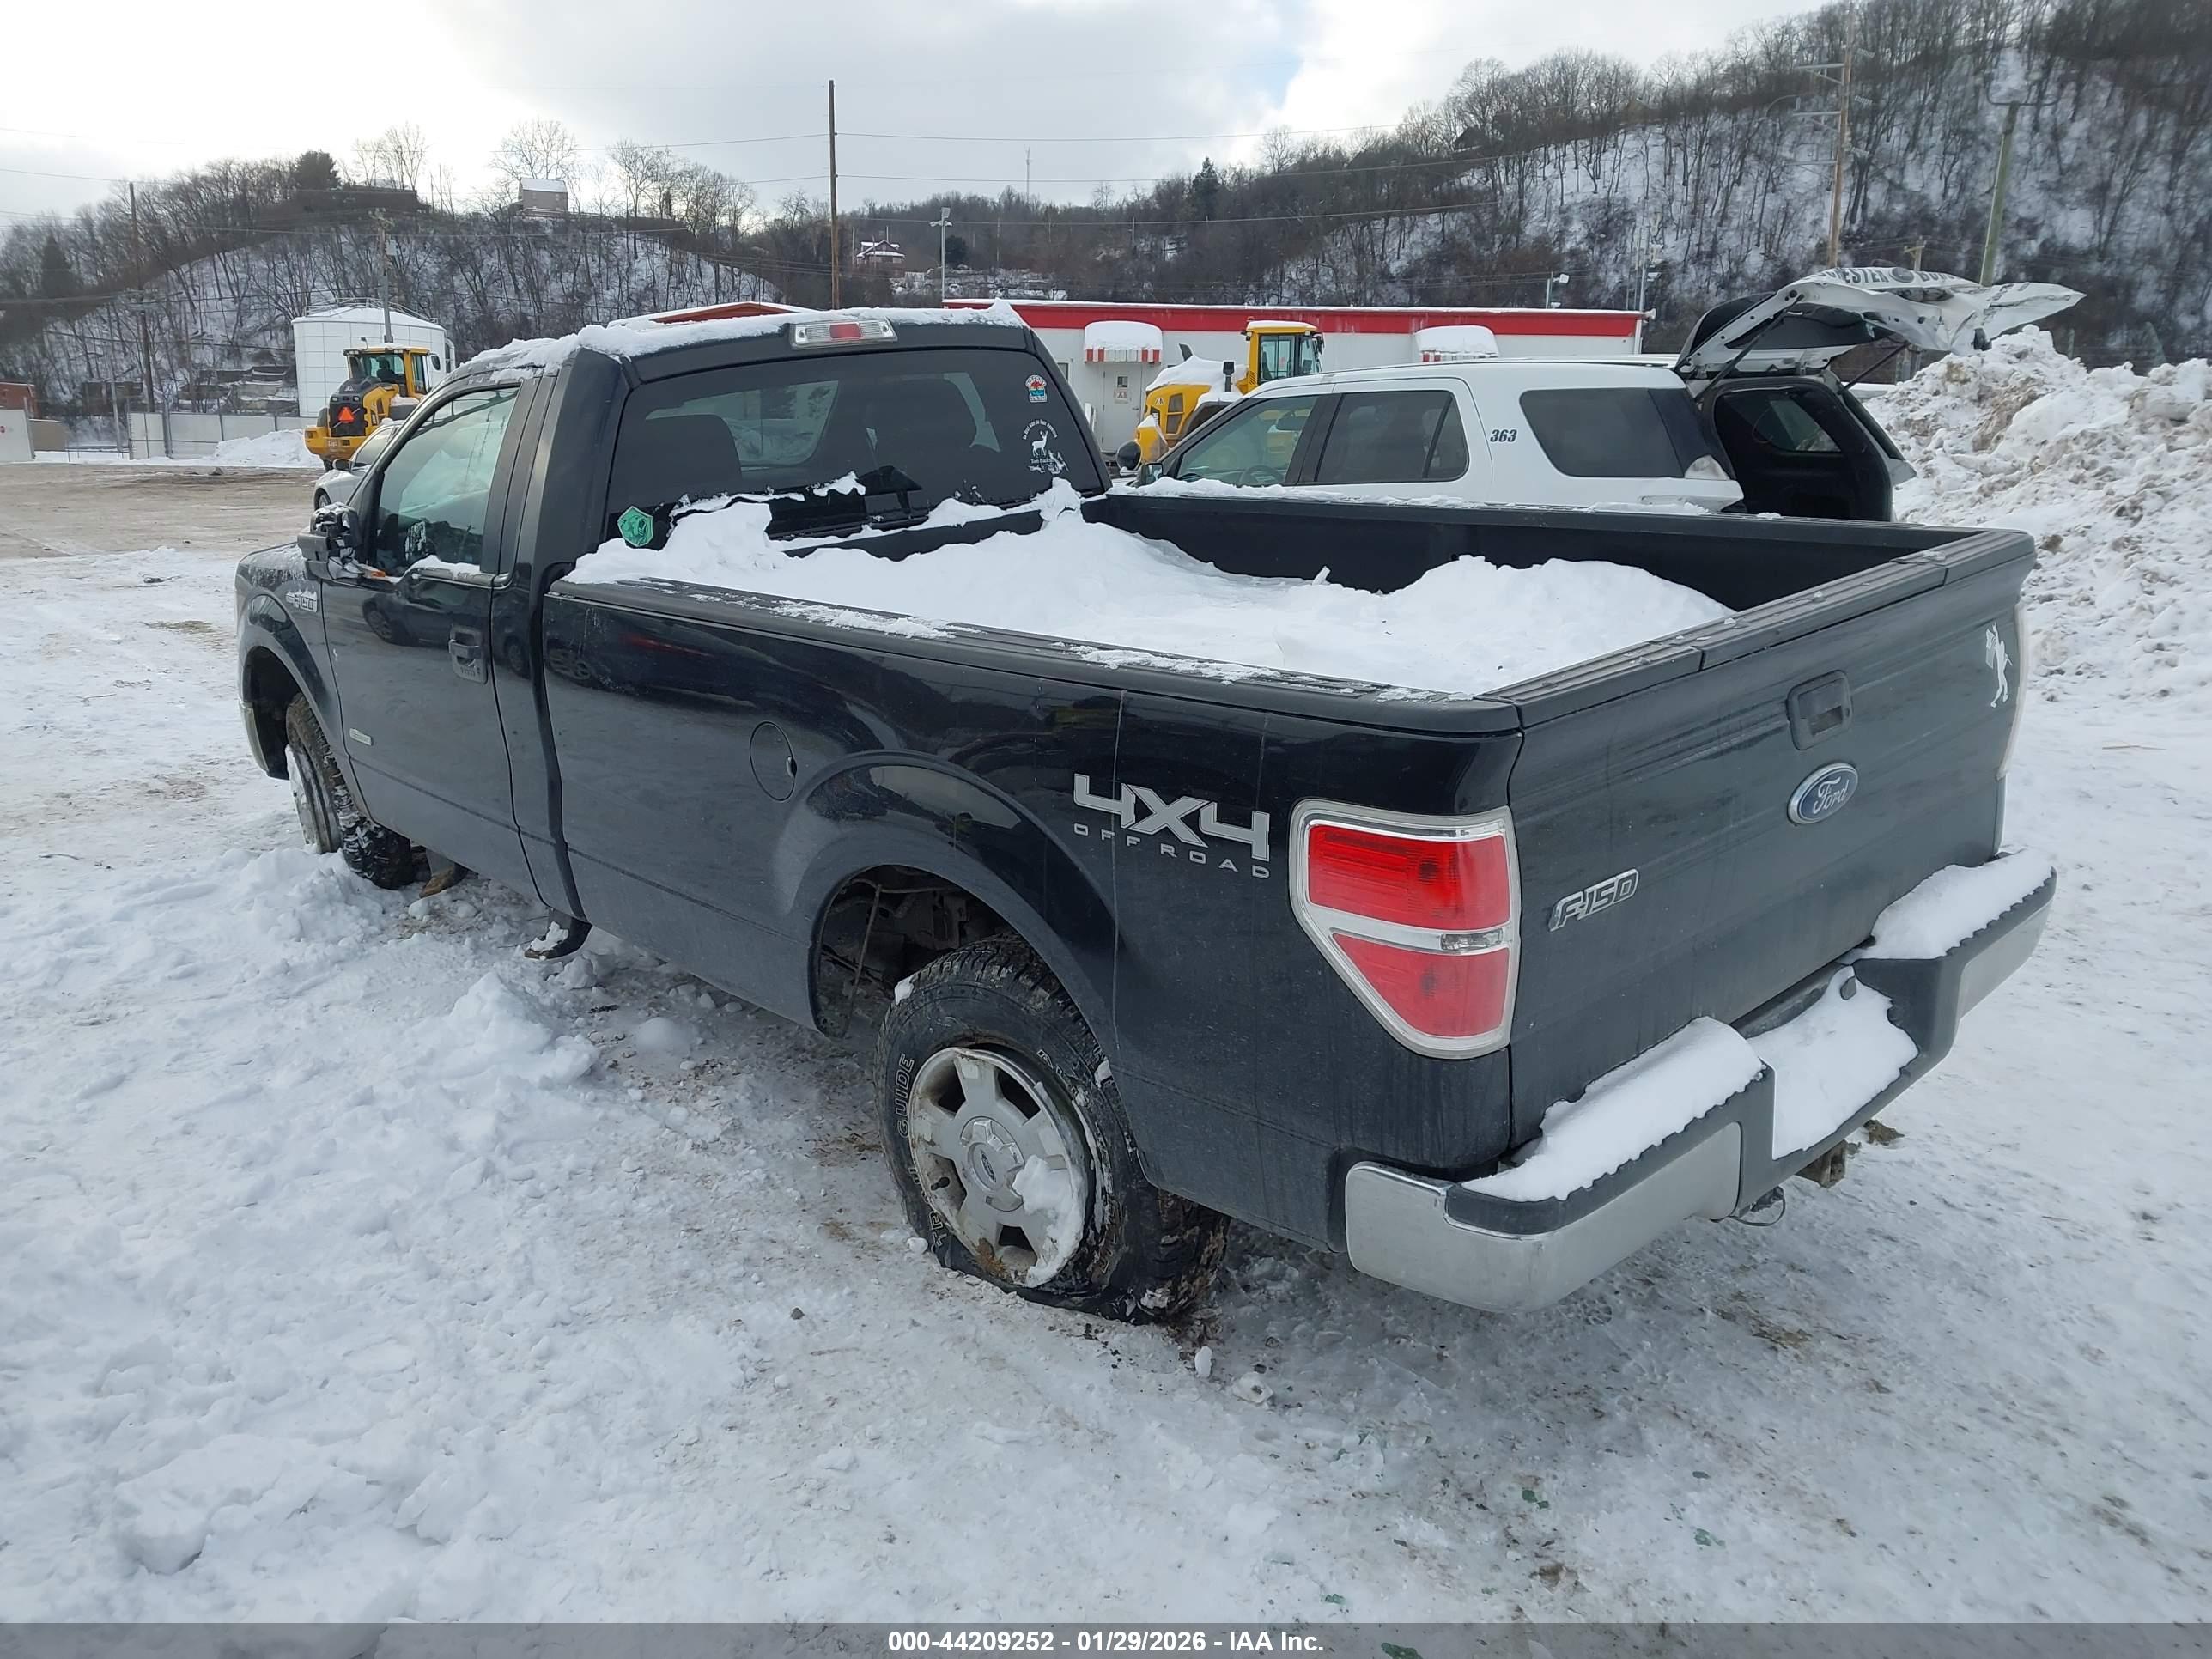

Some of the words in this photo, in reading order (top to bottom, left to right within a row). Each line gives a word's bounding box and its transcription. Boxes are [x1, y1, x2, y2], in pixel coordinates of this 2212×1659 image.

[1490, 429, 1517, 442] 363
[1074, 823, 1141, 847] OFF
[1160, 842, 1270, 878] ROAD
[1549, 868, 1638, 932] F-150
[895, 1053, 915, 1138] GUIDE
